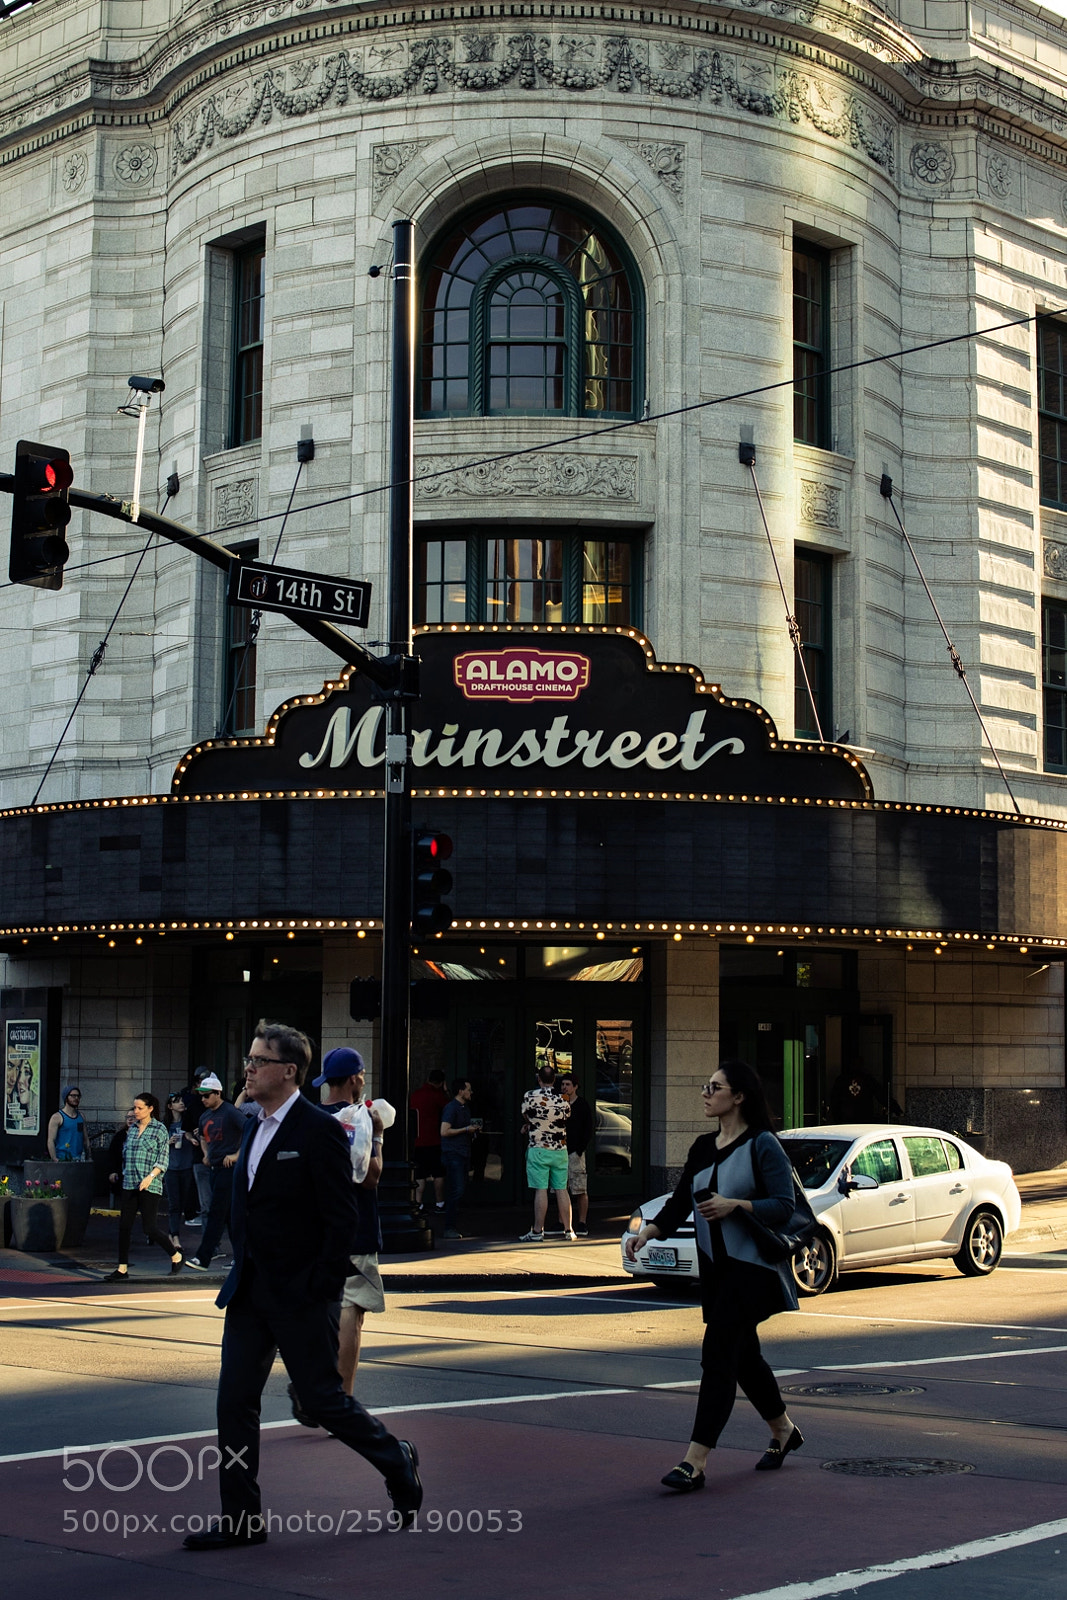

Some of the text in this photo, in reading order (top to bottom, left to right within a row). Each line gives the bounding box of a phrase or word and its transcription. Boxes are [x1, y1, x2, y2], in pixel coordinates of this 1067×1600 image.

[276, 579, 355, 614] 14th St
[466, 660, 579, 681] ALAMO
[471, 683, 573, 692] DRAFTHOUSE CINEMA
